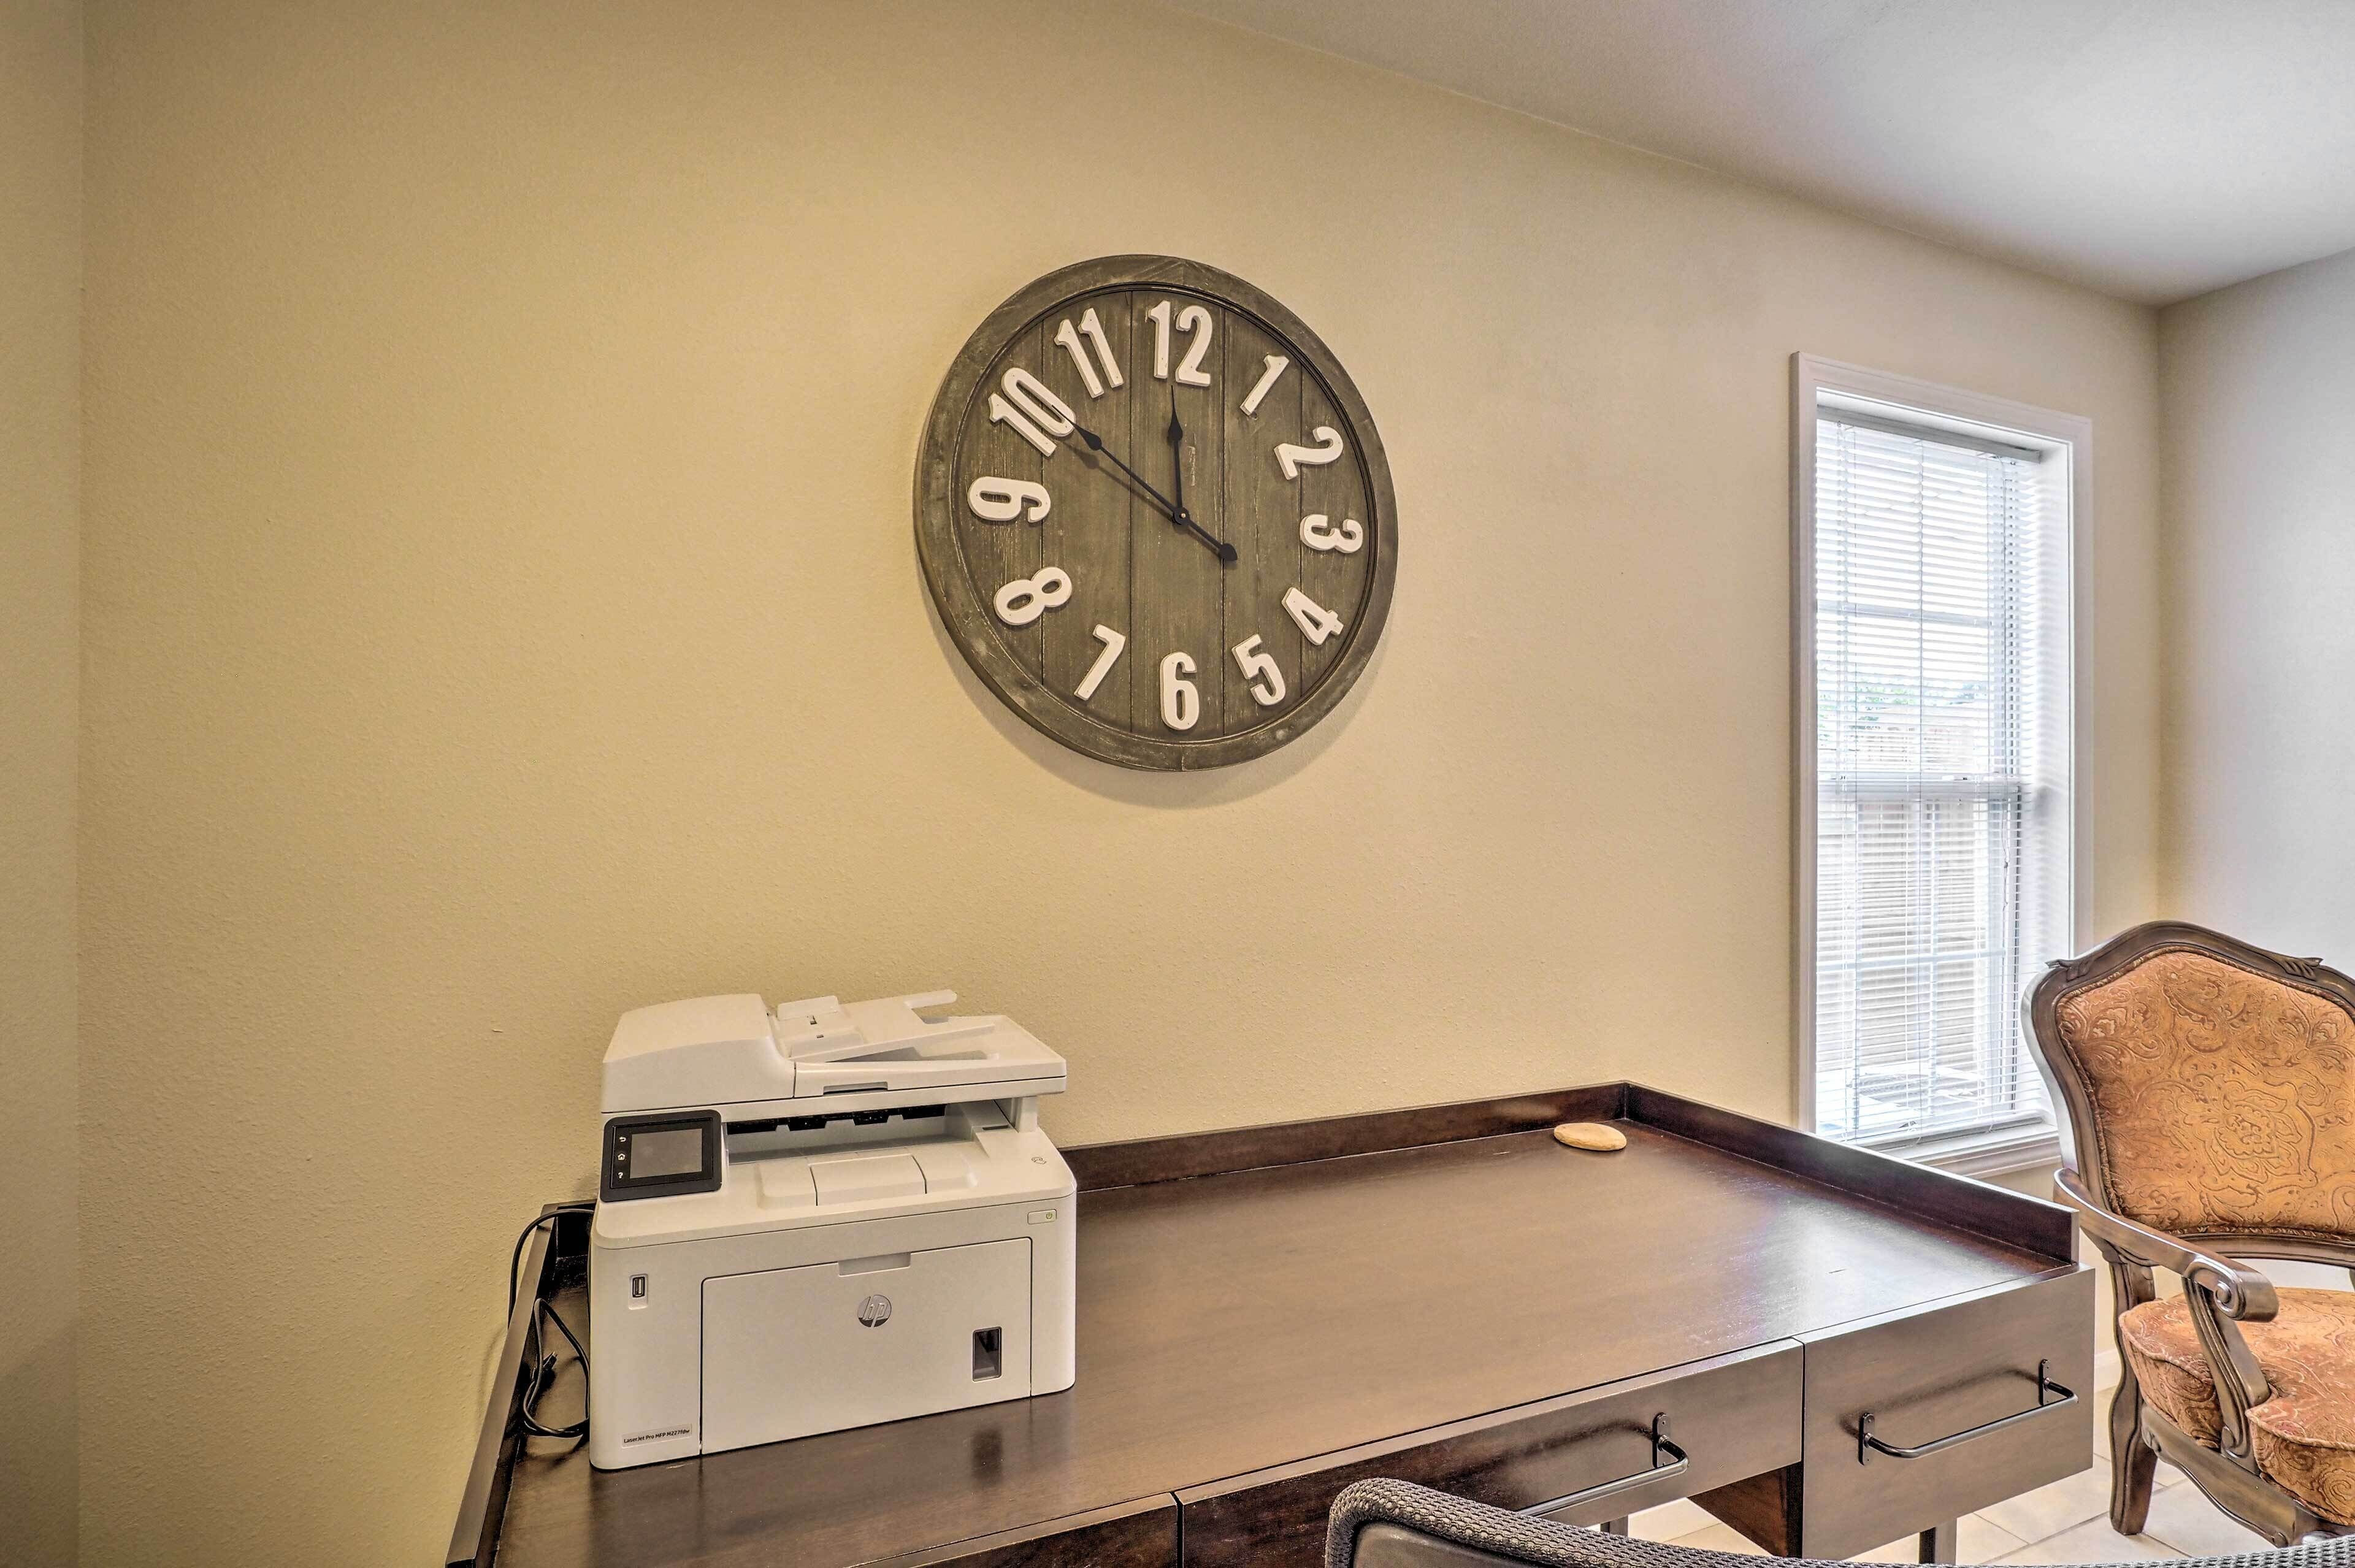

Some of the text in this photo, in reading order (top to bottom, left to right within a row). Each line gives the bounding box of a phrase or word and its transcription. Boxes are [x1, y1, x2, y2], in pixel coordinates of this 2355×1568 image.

[1054, 307, 1124, 399] 11
[1147, 300, 1212, 387] 12
[988, 367, 1076, 457] 10
[1240, 353, 1290, 416] 1
[1273, 426, 1344, 480] 2
[967, 476, 1051, 523] 9
[1300, 514, 1363, 554] 3
[993, 566, 1073, 626] 8
[1281, 586, 1344, 646] 4
[1073, 623, 1127, 701] 7
[1160, 651, 1200, 730] 6
[1231, 633, 1287, 706] 5
[857, 1295, 892, 1328] hp
